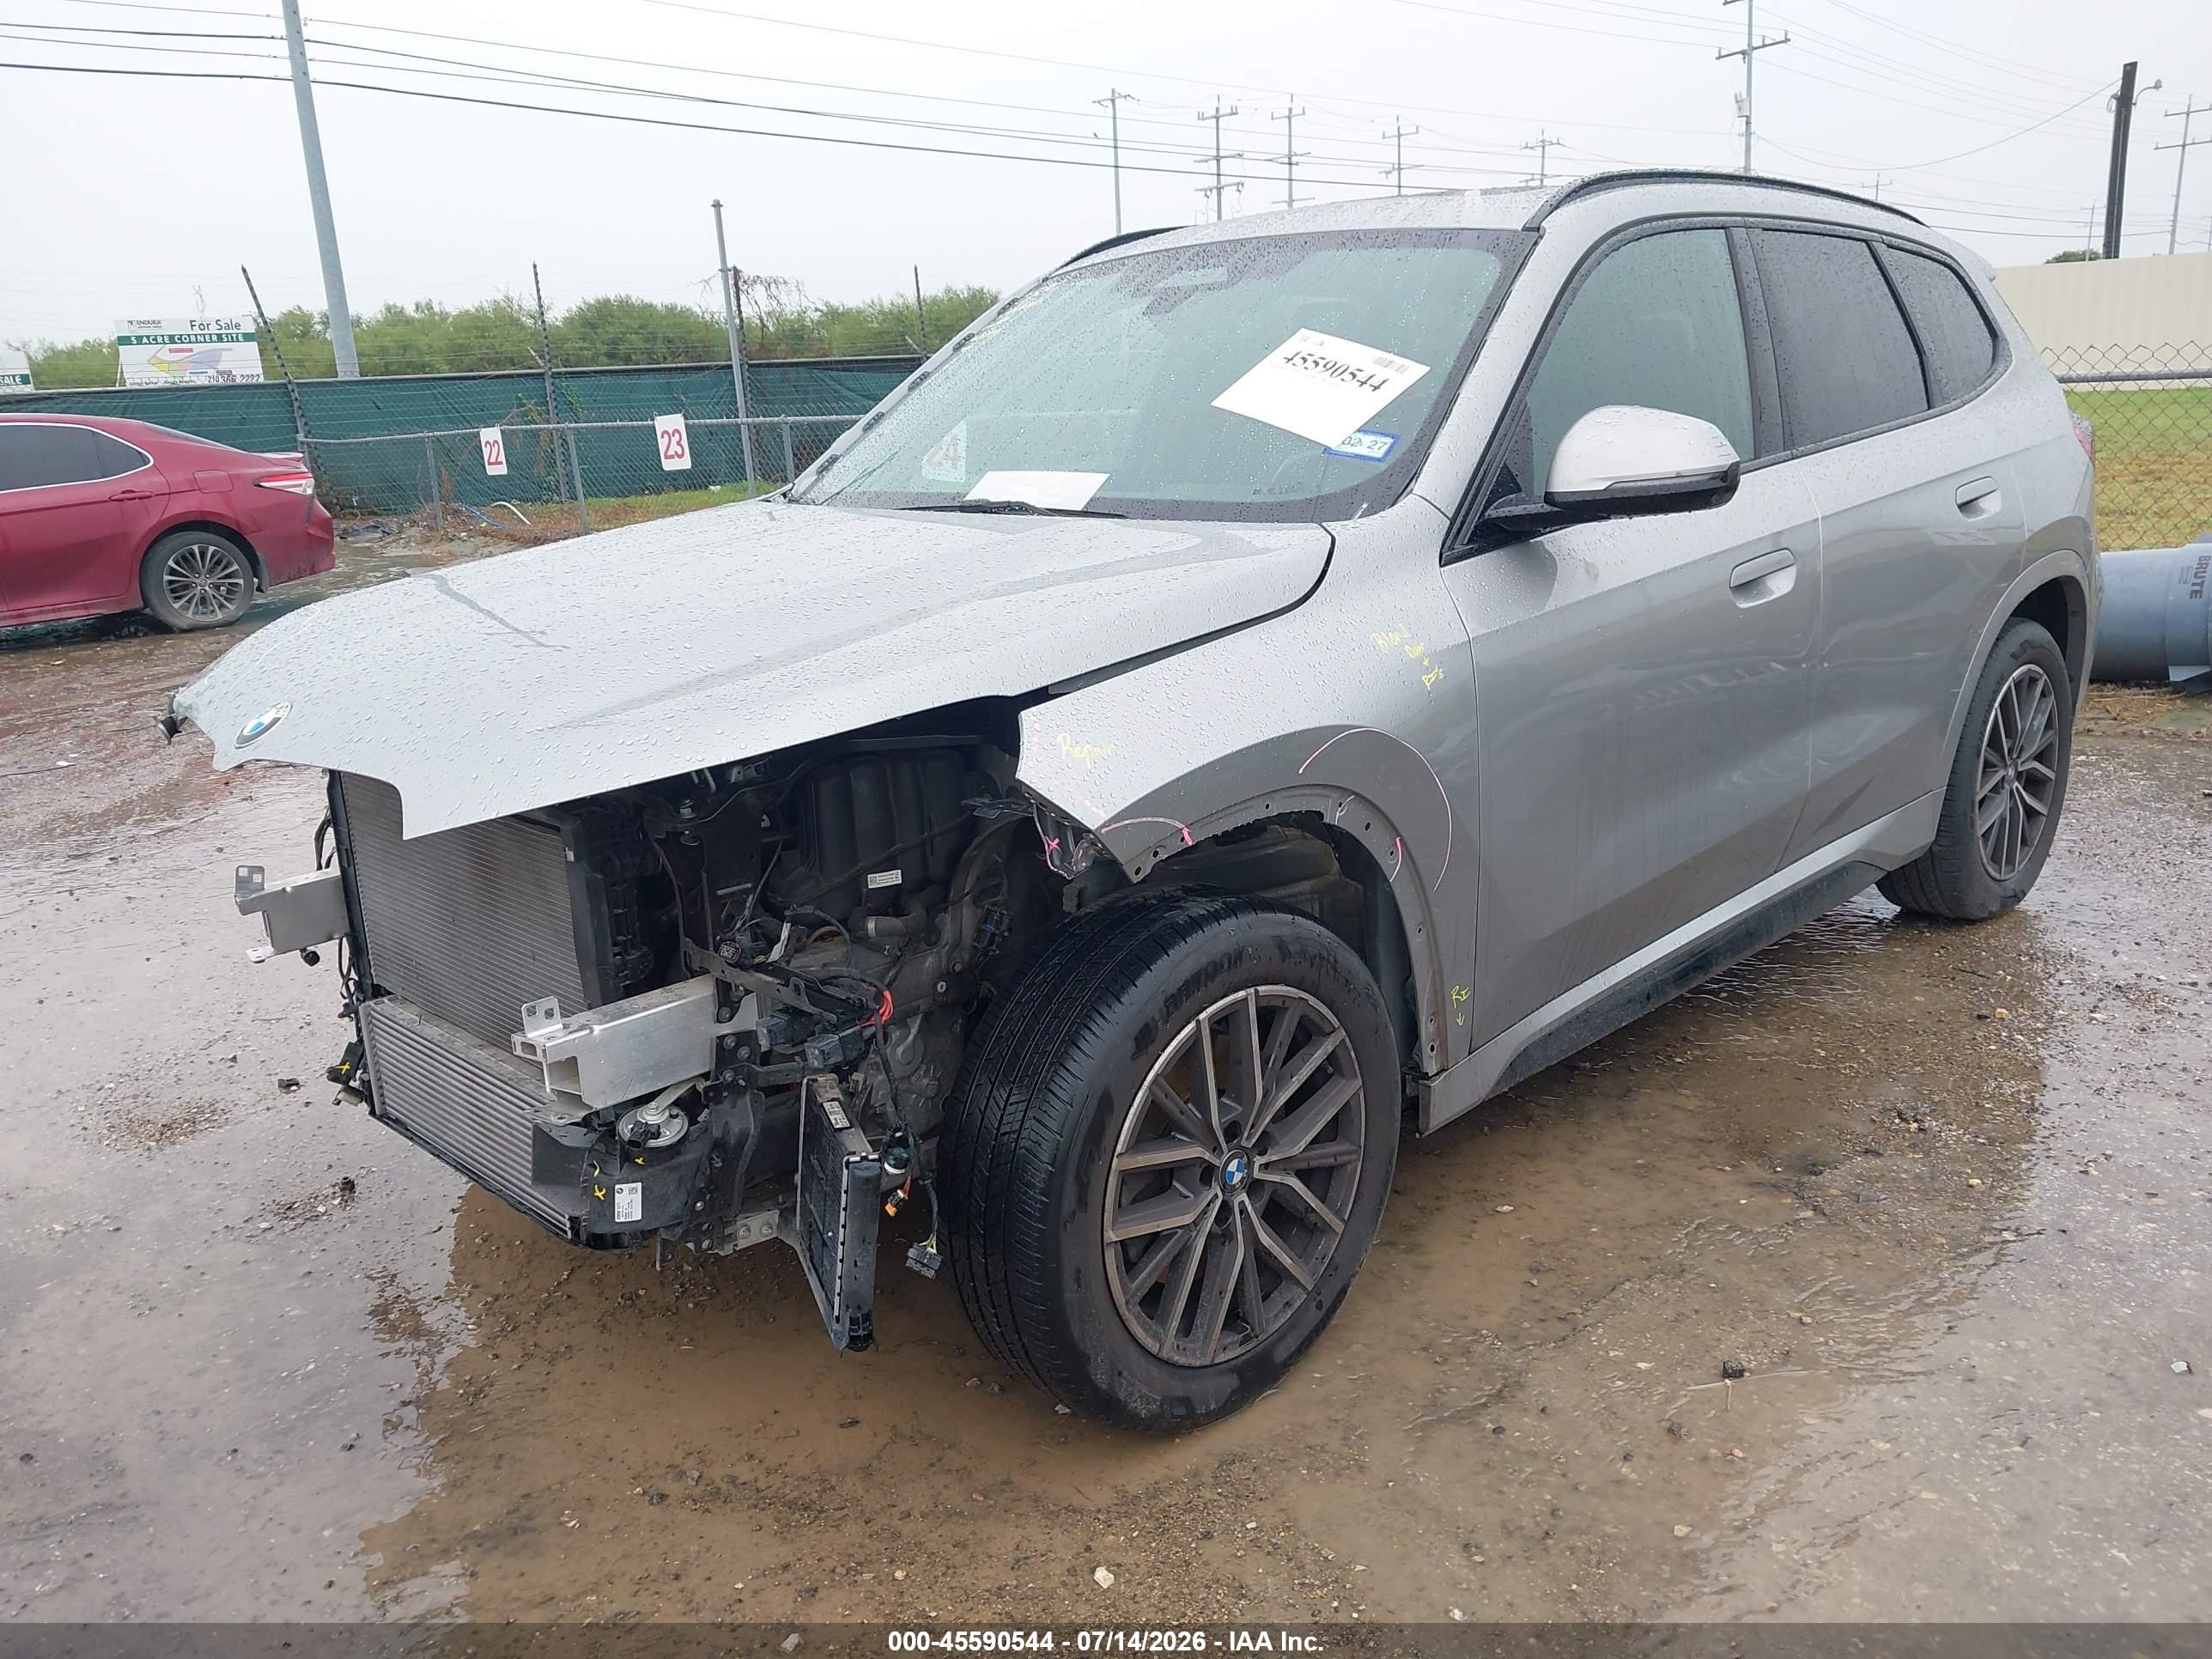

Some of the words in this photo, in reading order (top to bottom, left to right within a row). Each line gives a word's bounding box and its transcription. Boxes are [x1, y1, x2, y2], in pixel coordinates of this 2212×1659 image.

[189, 319, 211, 331] For
[215, 318, 241, 331] Sale
[131, 336, 137, 344] 5
[142, 335, 170, 344] ACRE
[173, 334, 218, 343] CORNER
[222, 333, 245, 342] SITE
[0, 374, 23, 385] SALE
[1282, 350, 1390, 392] 45590544
[483, 439, 503, 466] 22
[660, 428, 685, 460] 23
[1366, 439, 1389, 451] 27
[2189, 555, 2212, 600] BRUTE
